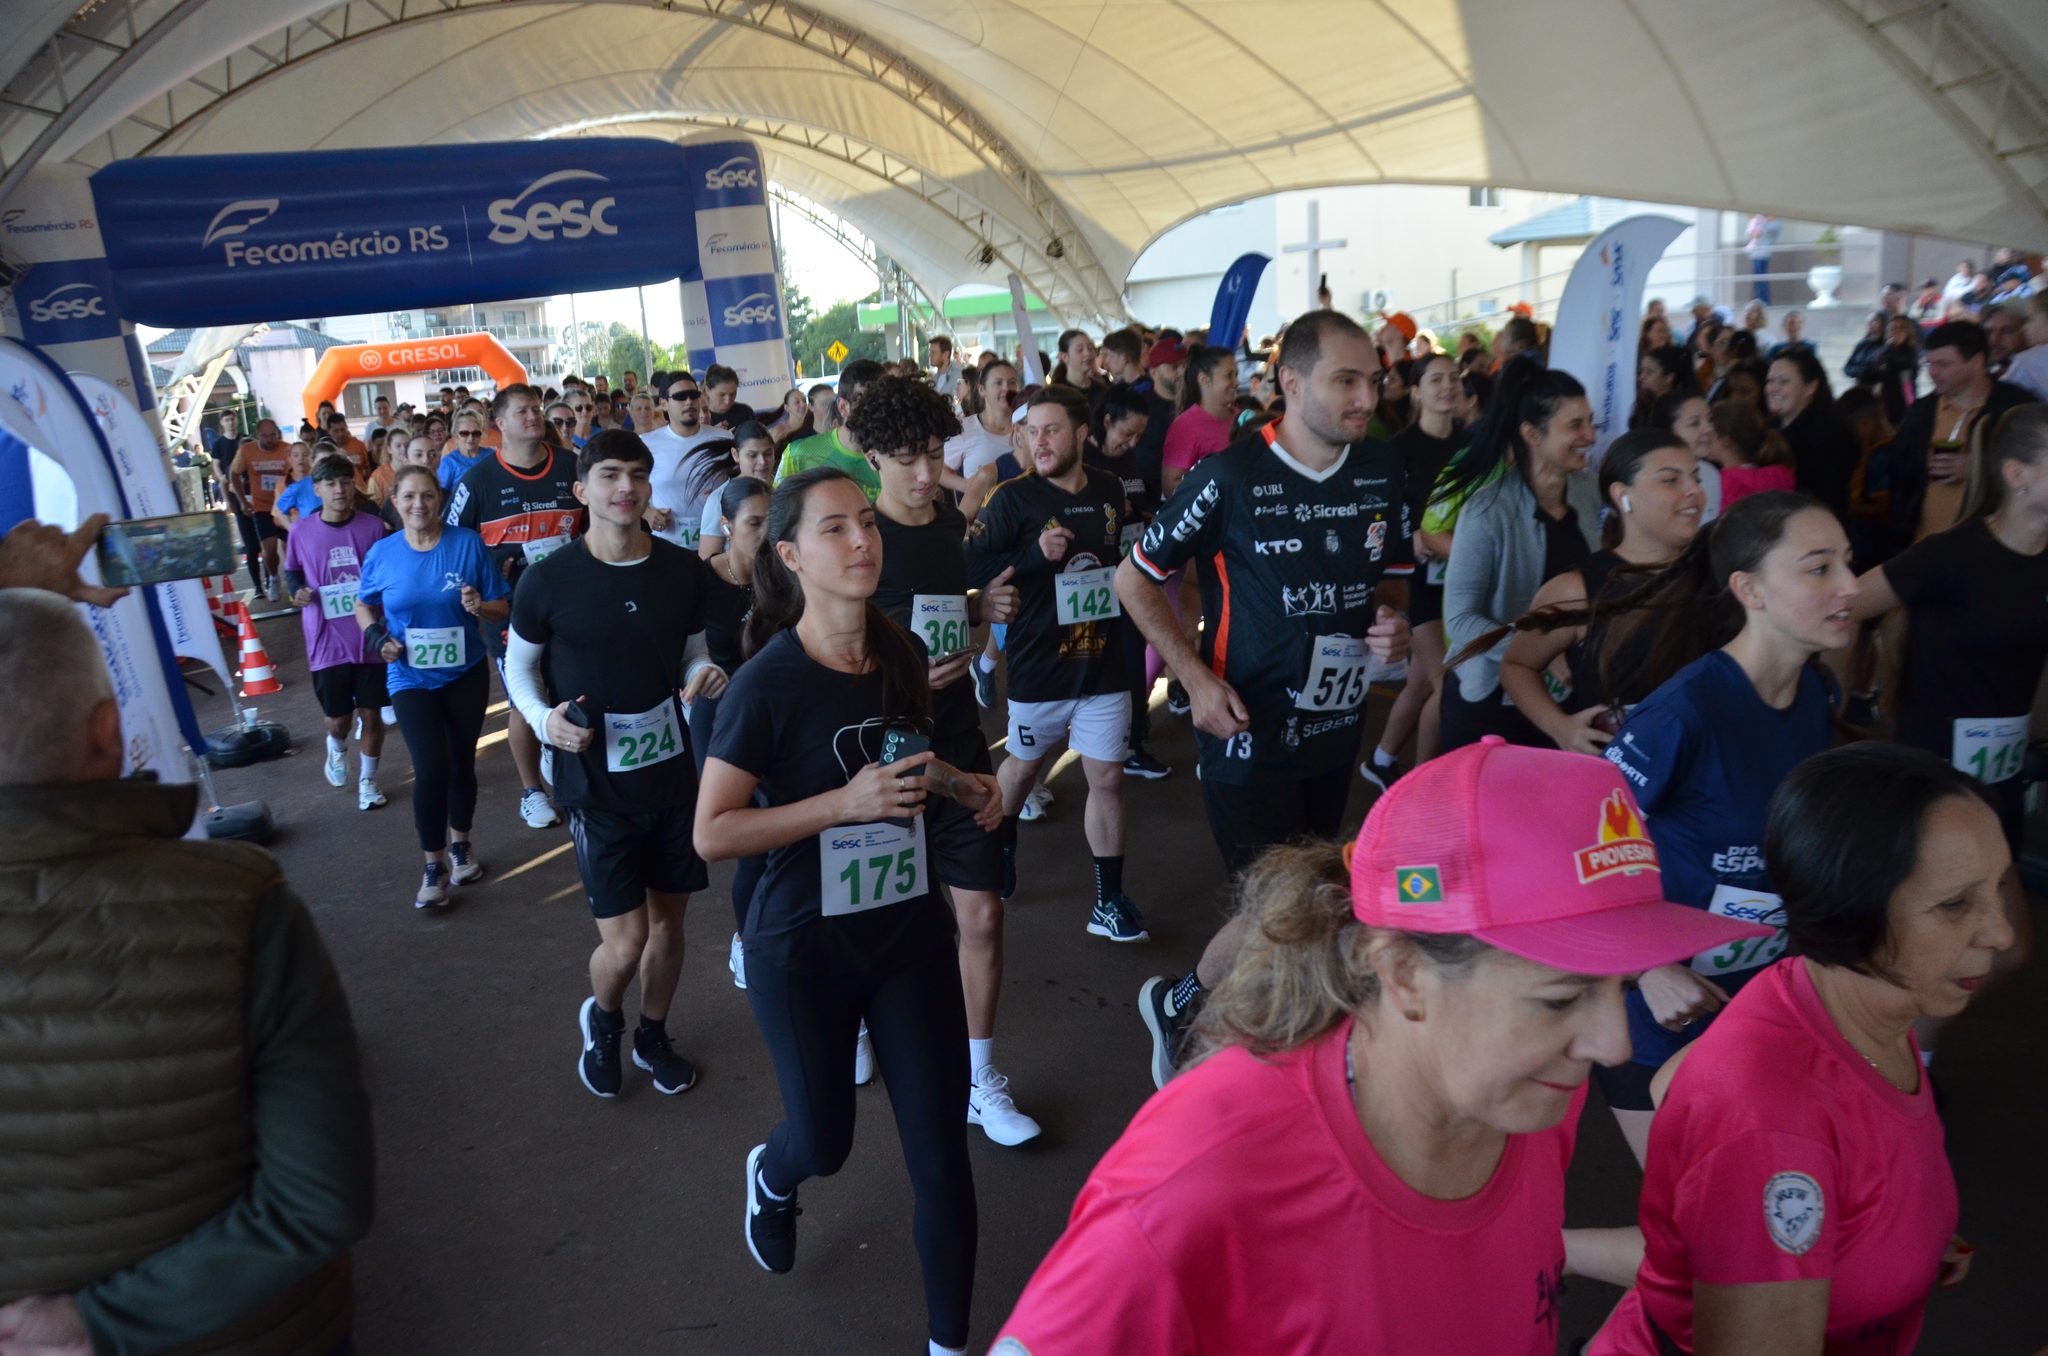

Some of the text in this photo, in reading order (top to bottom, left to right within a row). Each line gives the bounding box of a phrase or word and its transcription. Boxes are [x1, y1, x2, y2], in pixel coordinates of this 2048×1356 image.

[704, 168, 758, 190] Sesc
[6, 218, 95, 234] Fecomércio RS
[487, 197, 618, 245] Sesc
[224, 225, 449, 267] Fecomércio RS
[709, 240, 760, 255] Fecomércio
[29, 296, 106, 323] Sesc
[723, 303, 777, 327] Sesc
[387, 343, 467, 366] CRESOL
[737, 375, 780, 389] ecomércio
[1262, 483, 1284, 496] URI
[531, 500, 558, 510] Sicredi
[1312, 503, 1358, 518] Sicredi
[1254, 538, 1303, 555] KTO
[921, 604, 940, 612] Sesc
[1066, 587, 1112, 619] 142
[923, 619, 969, 657] 360
[414, 643, 458, 666] 278
[1321, 647, 1342, 657] Sesc
[1313, 665, 1366, 707] 515
[612, 720, 632, 730] Sesc
[1018, 724, 1036, 747] 6
[617, 723, 676, 767] 224
[831, 837, 862, 850] Sesc
[1727, 845, 1758, 857] pro
[839, 847, 917, 906] 175
